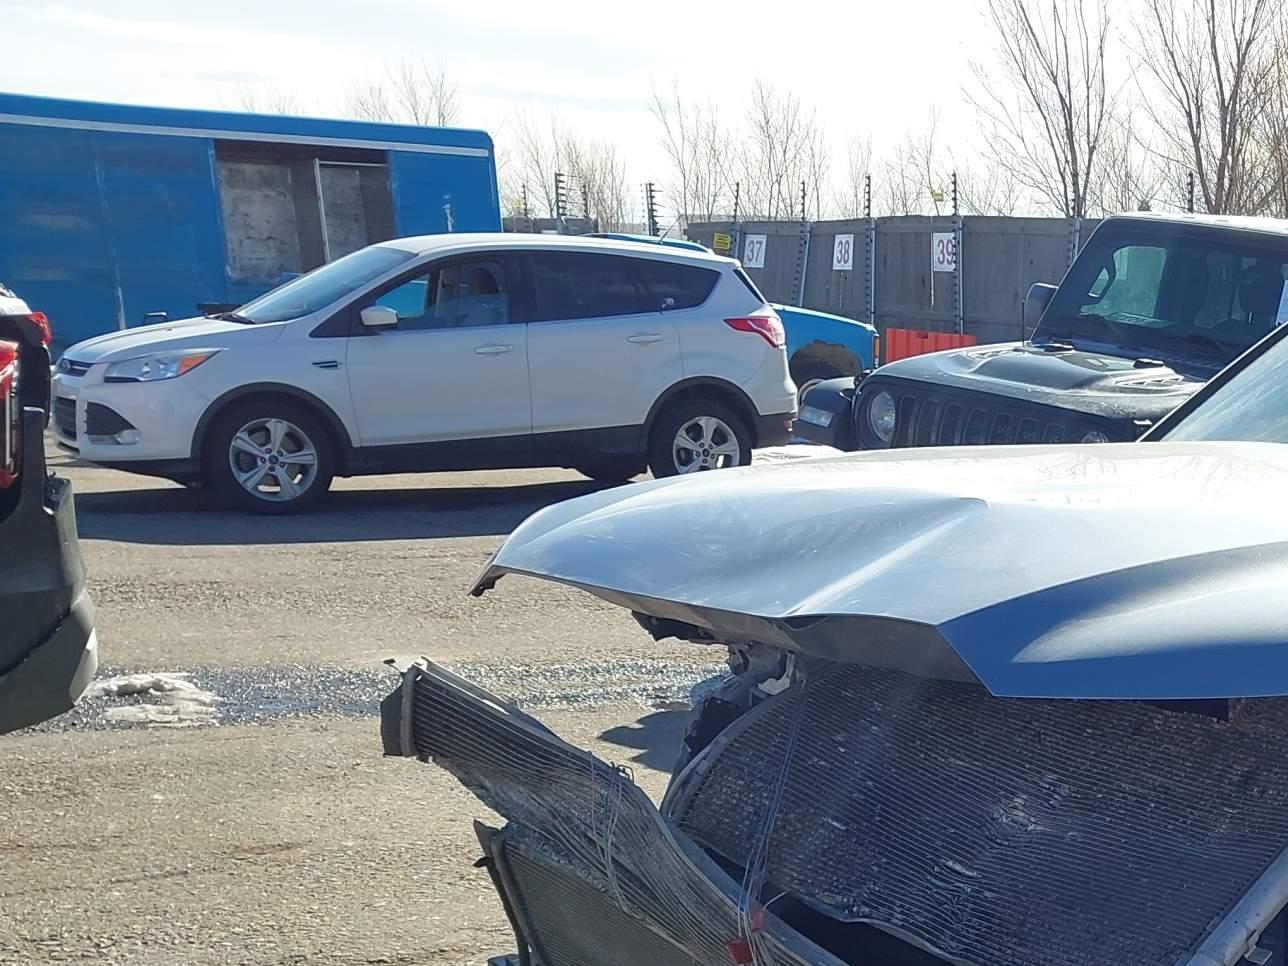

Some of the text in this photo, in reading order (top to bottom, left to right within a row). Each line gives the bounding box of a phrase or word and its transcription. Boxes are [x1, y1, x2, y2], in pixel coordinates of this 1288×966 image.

[747, 240, 763, 262] 37
[836, 239, 850, 265] 38
[937, 238, 954, 266] 39
